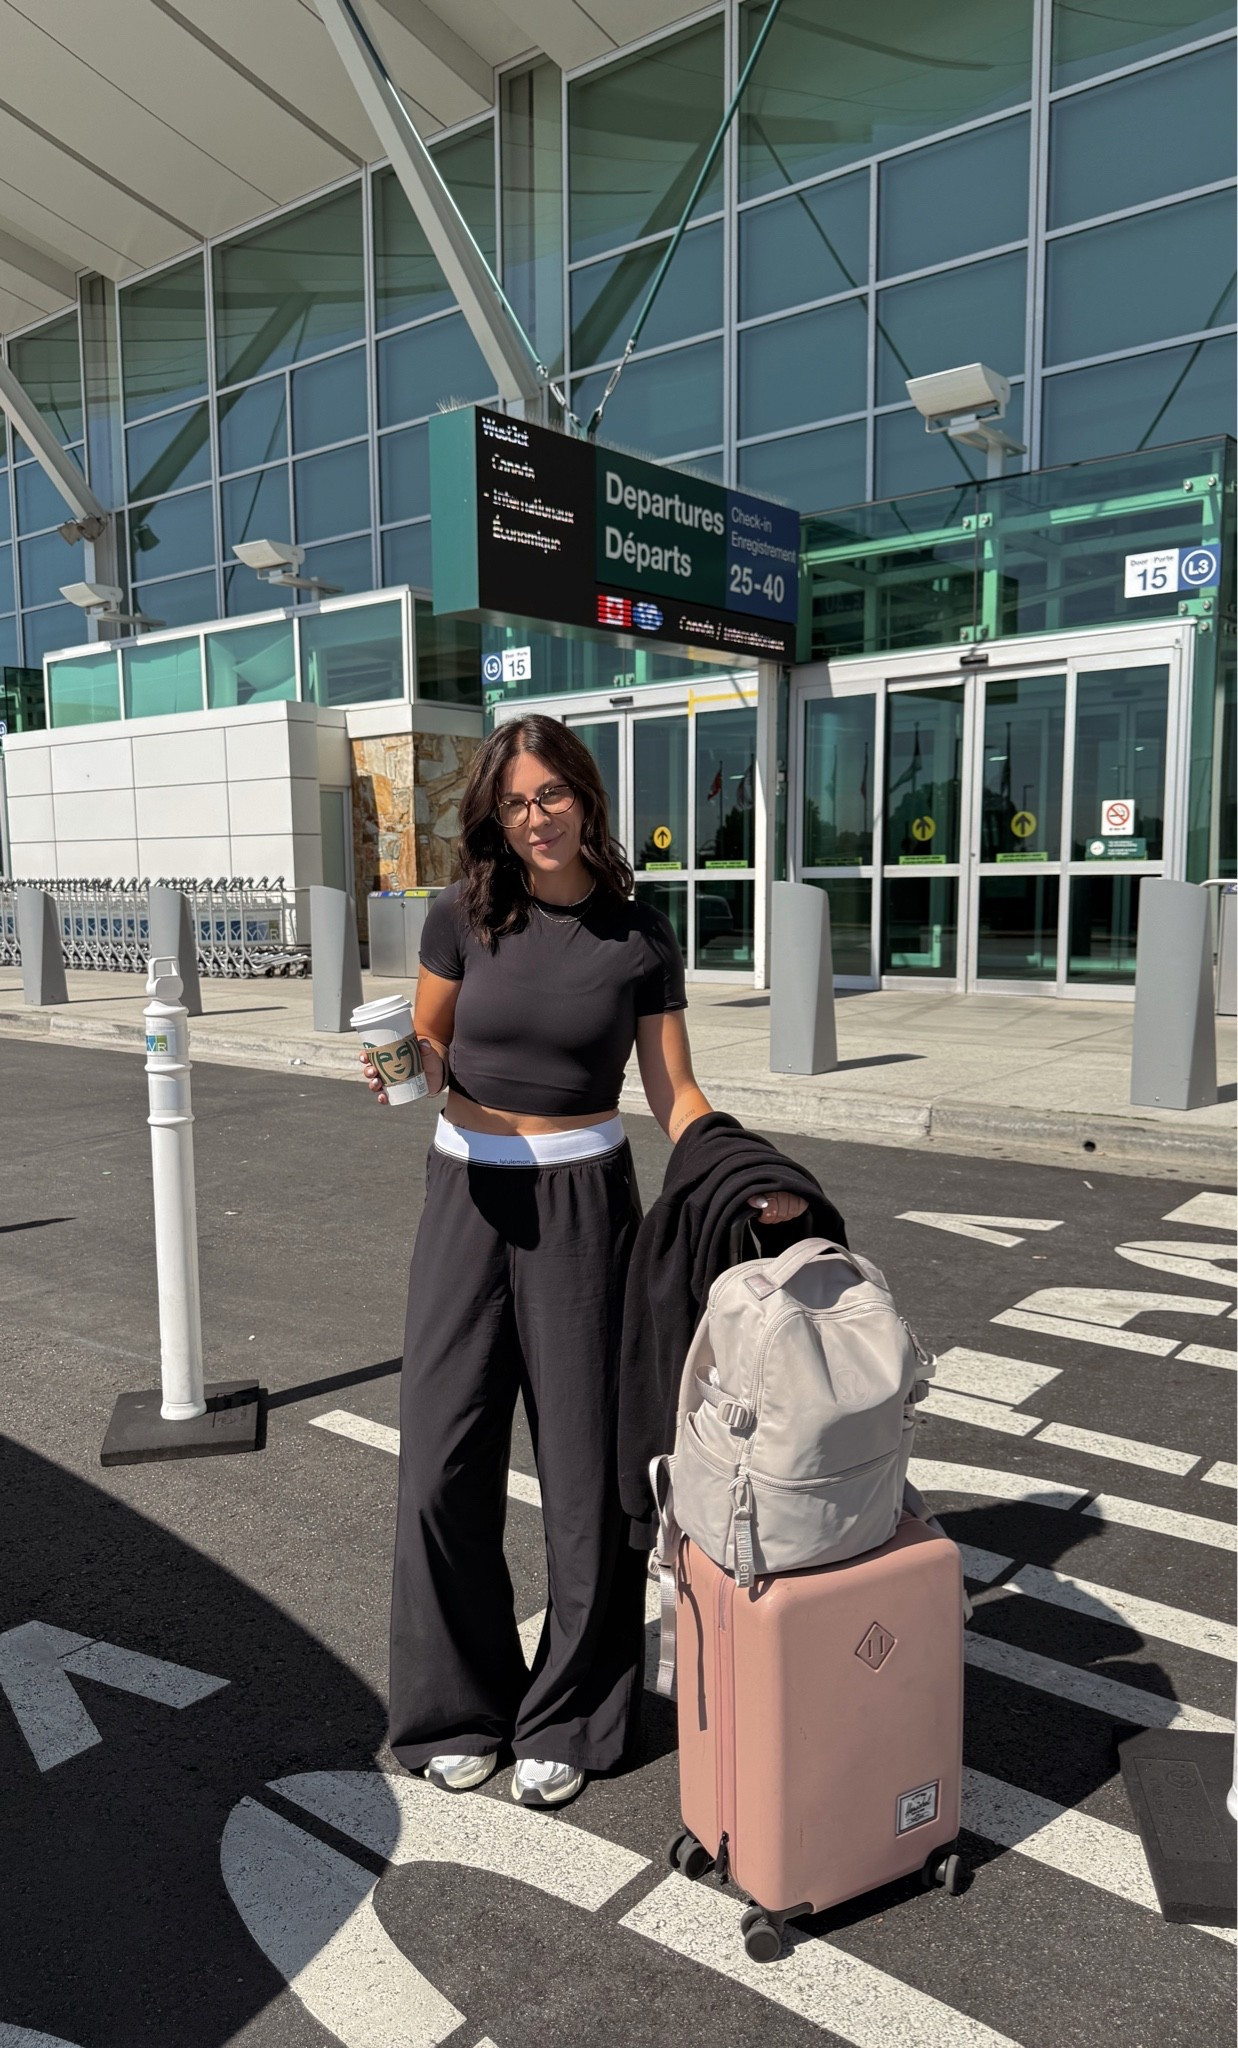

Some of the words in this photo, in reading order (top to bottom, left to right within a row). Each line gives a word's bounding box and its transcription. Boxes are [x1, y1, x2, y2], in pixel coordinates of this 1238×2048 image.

[605, 471, 725, 535] Departures
[731, 506, 773, 533] Check-in
[605, 526, 692, 577] Départs
[731, 530, 796, 564] Enregistrement
[1137, 566, 1168, 591] 15
[1188, 559, 1209, 576] L3
[729, 563, 785, 604] 25-40
[487, 662, 498, 674] L3
[508, 660, 526, 677] 15
[246, 928, 280, 941] YVR
